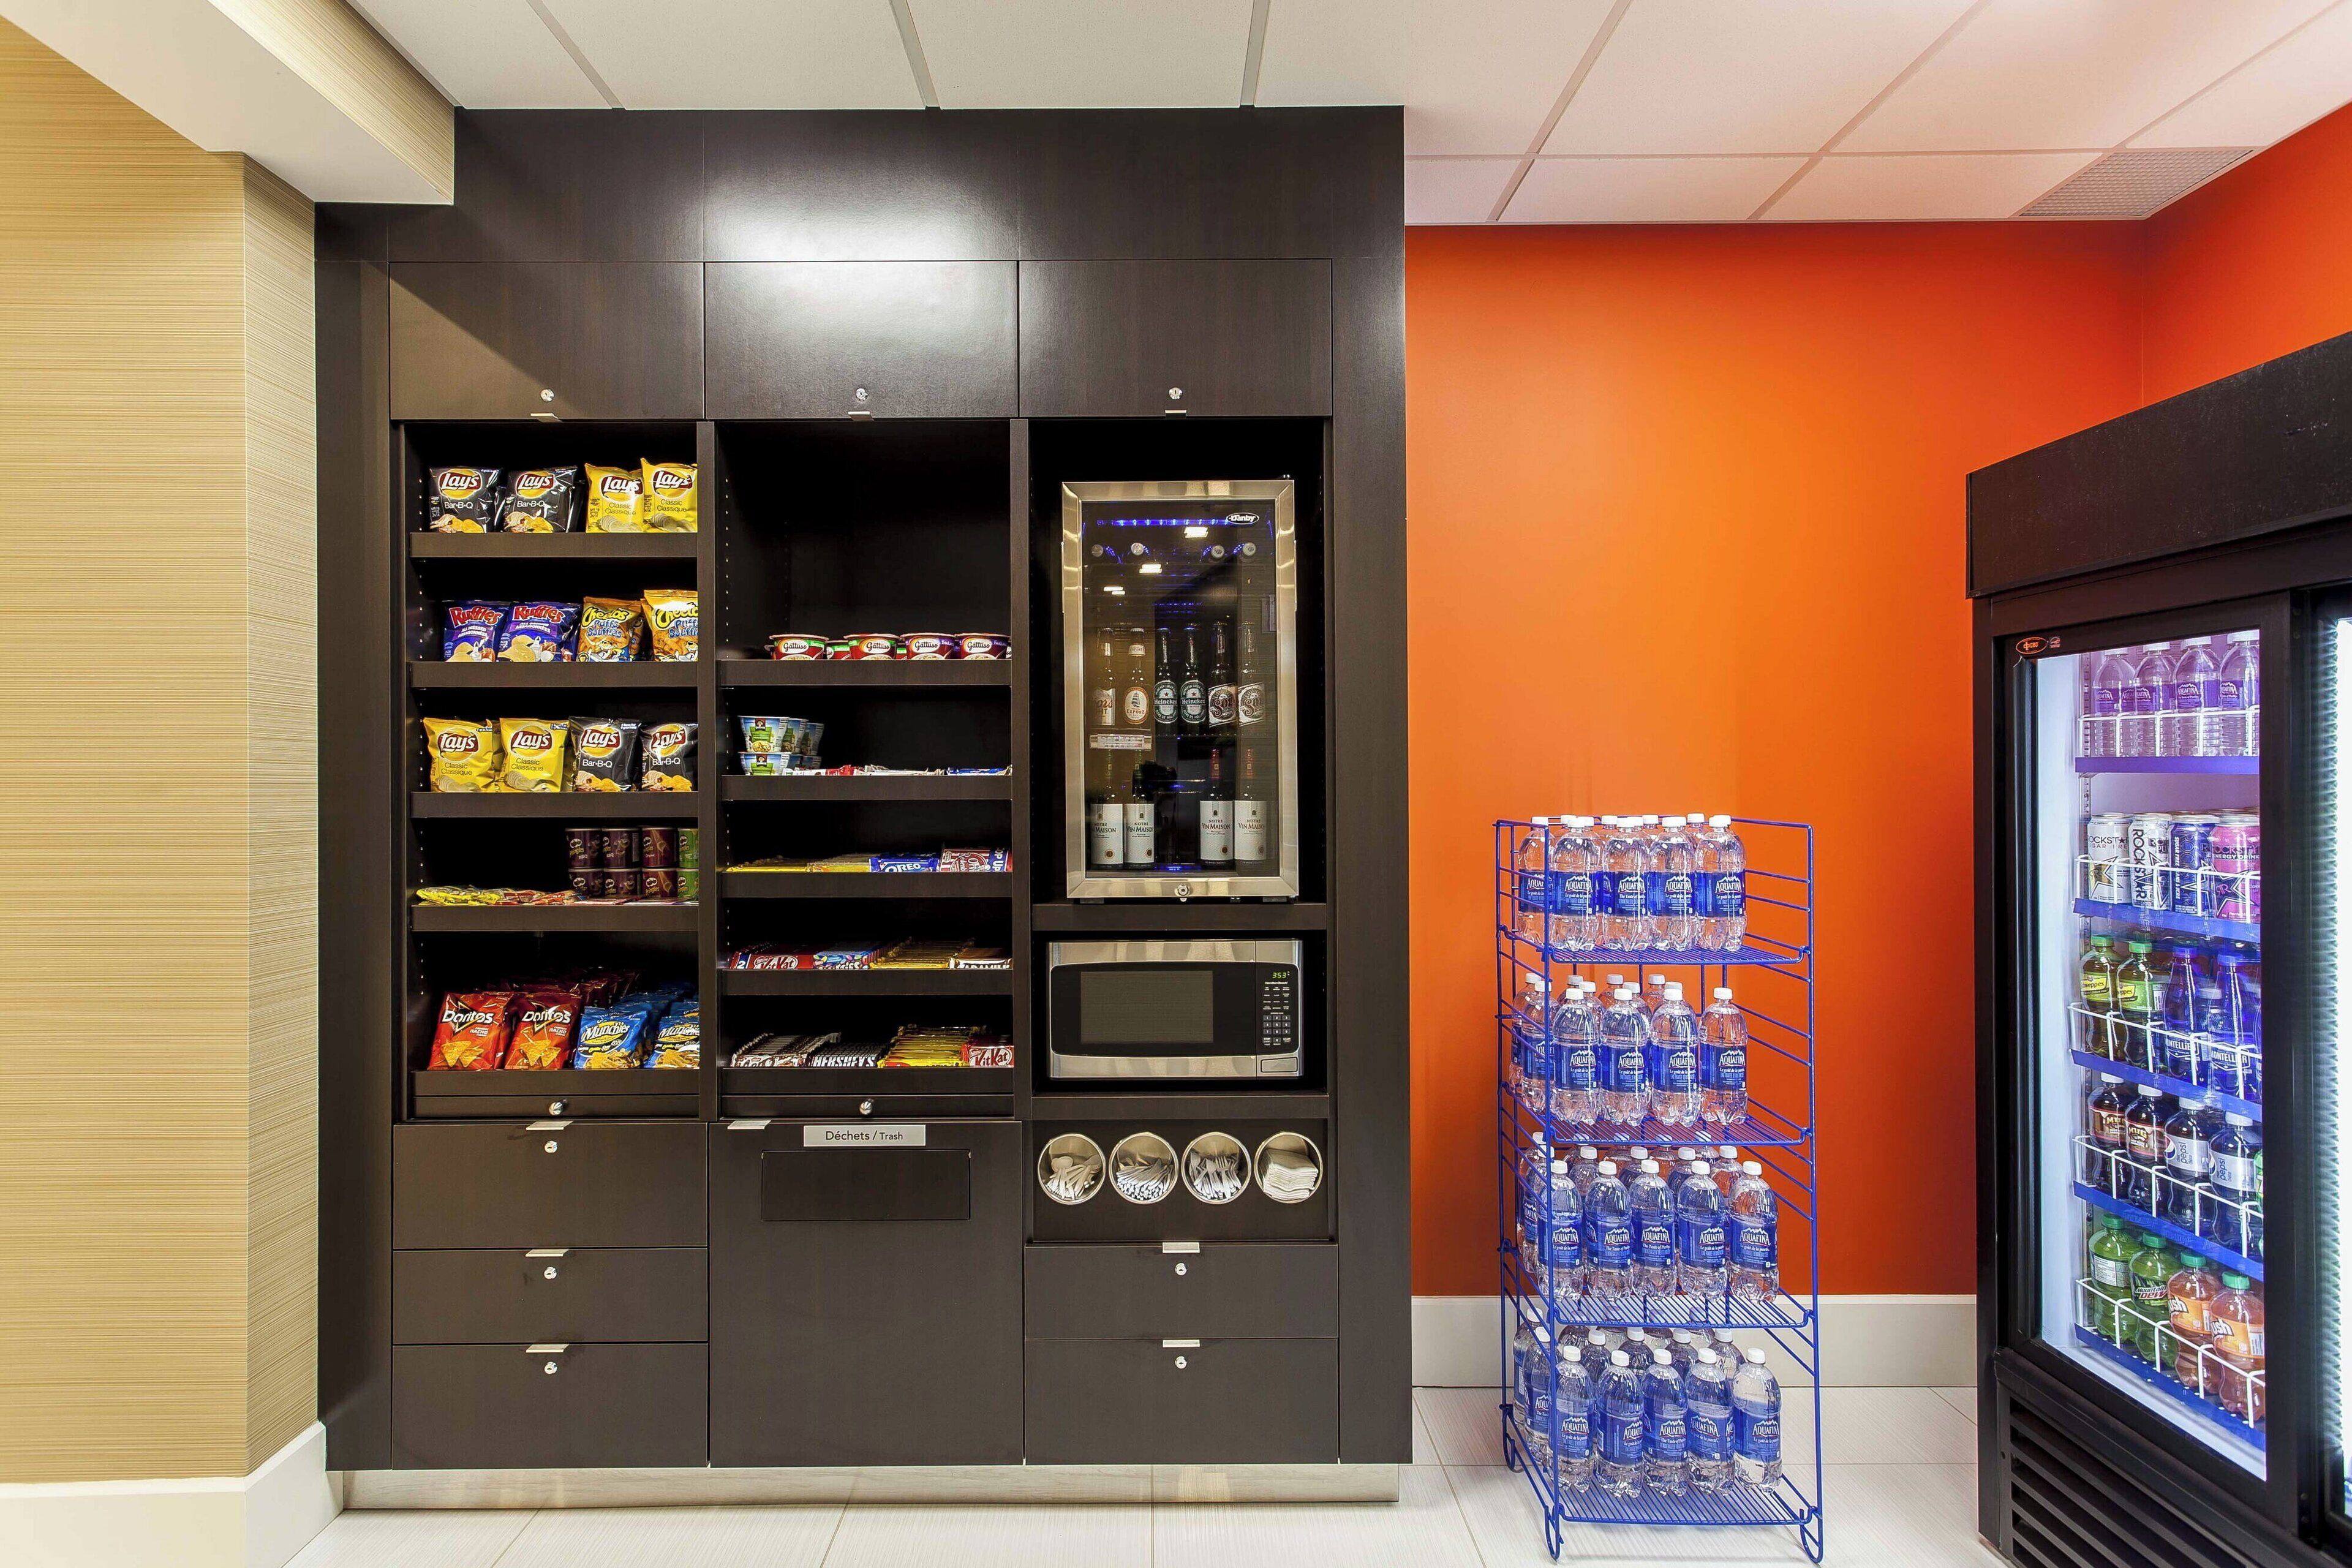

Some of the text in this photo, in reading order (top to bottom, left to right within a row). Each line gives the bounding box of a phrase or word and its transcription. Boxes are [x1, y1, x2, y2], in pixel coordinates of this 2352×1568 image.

[449, 606, 503, 628] Ruffles
[513, 605, 565, 624] Ruffles
[783, 642, 807, 651] Gattuso
[866, 642, 889, 651] Gattuso
[914, 641, 938, 650] Gattuso
[967, 641, 990, 650] Gattuso
[1564, 881, 1593, 892] AQUAFINA
[1665, 881, 1692, 892] AQUAFINA
[442, 1010, 495, 1024] Doritos
[522, 1011, 572, 1024] Doritos
[581, 1023, 630, 1042] Munchies
[1569, 1055, 1596, 1066] AQUAFINA
[1668, 1057, 1696, 1068] AQUAFINA
[1719, 1055, 1746, 1066] AQUAFINA
[826, 1130, 870, 1140] Déchets
[872, 1130, 878, 1140] /
[2128, 1127, 2147, 1139] MUG
[2179, 1141, 2189, 1164] pepsi
[2218, 1157, 2228, 1181] pepsi
[1552, 1232, 1579, 1244] AQUAFINA
[1604, 1234, 1630, 1245] AQUAFINA
[1642, 1232, 1670, 1243] AQUAFINA
[1698, 1232, 1725, 1245] AQUAFINA
[1740, 1232, 1771, 1245] AQUAFINA
[2212, 1318, 2234, 1336] ush
[1561, 1422, 1589, 1433] AQUAFINA
[1659, 1424, 1686, 1437] AQUAFINA
[1691, 1421, 1719, 1437] AQUAFINA
[1752, 1425, 1779, 1437] AQUAFINA
